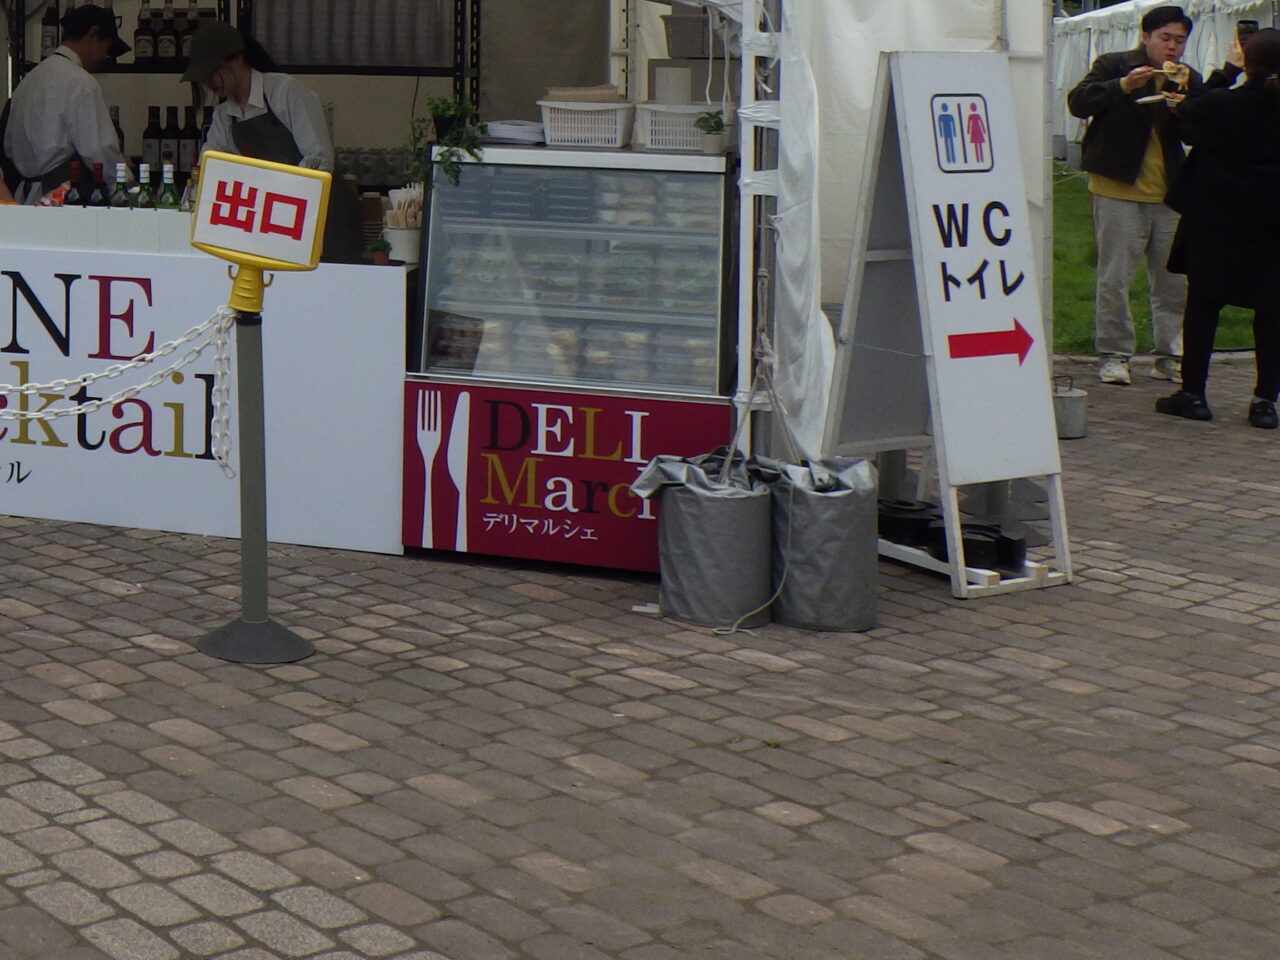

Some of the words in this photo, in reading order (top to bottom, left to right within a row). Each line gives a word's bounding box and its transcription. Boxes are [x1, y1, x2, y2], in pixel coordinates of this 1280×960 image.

[209, 180, 308, 241] 出口
[932, 200, 1012, 248] WC
[940, 259, 1025, 302] トイレ
[482, 400, 650, 464] DELI
[482, 513, 599, 541] デリマルシェ
